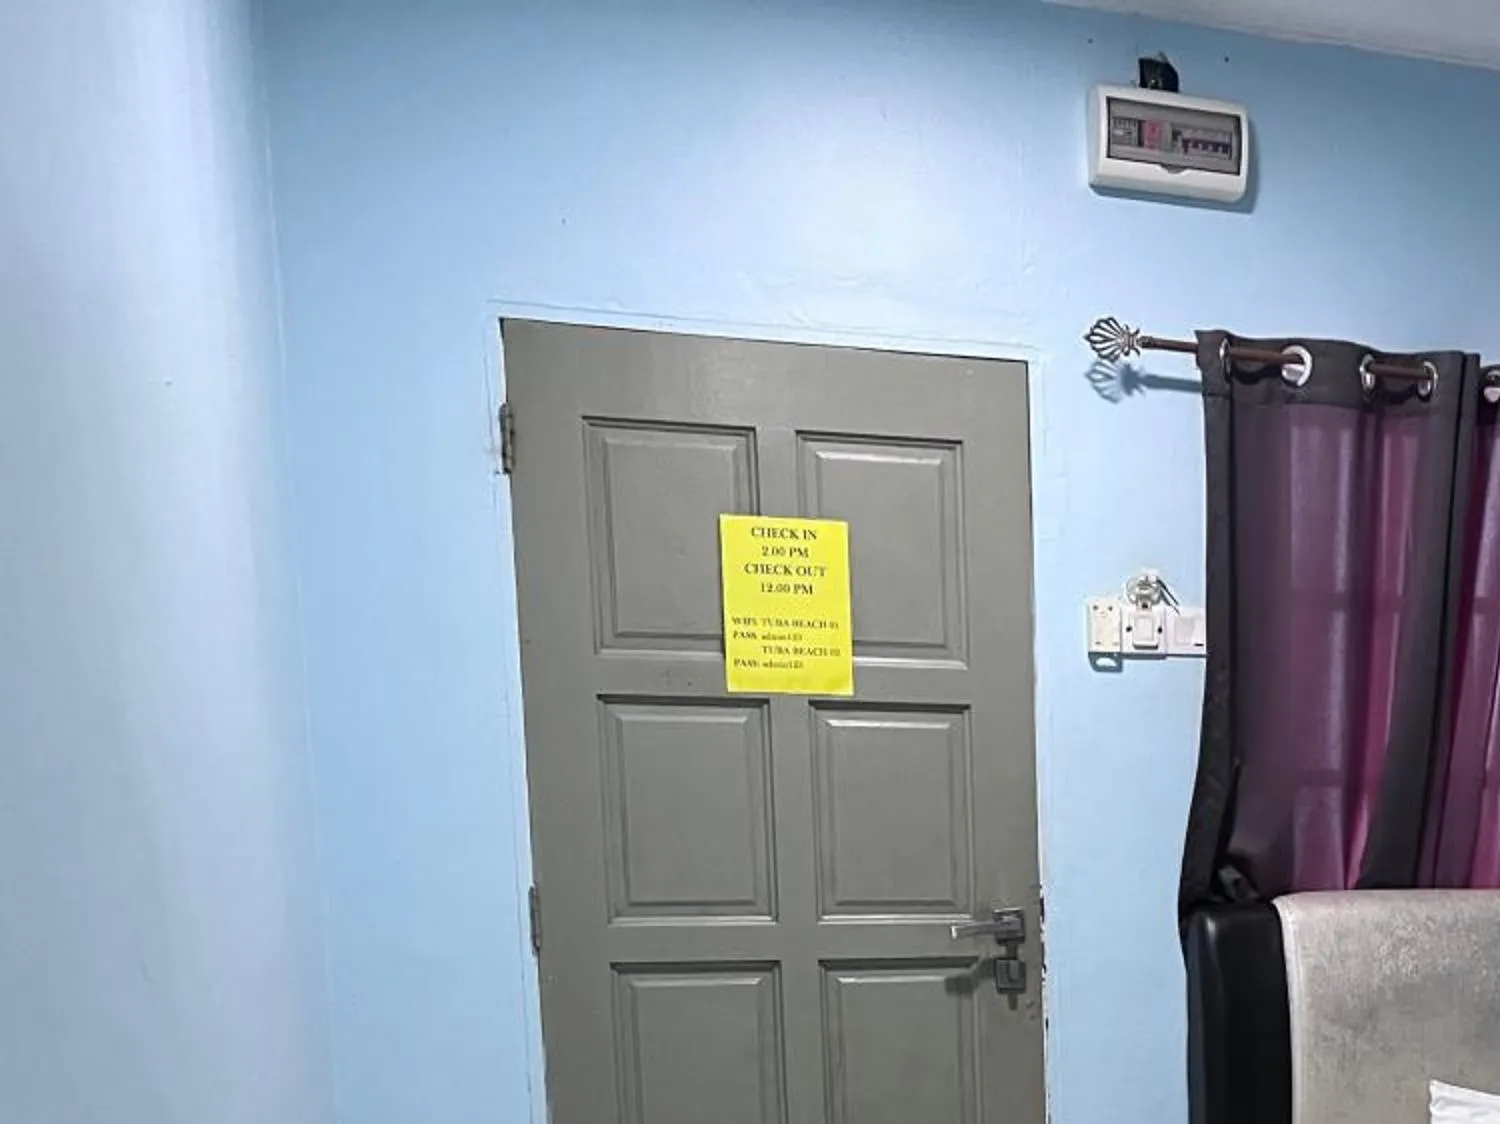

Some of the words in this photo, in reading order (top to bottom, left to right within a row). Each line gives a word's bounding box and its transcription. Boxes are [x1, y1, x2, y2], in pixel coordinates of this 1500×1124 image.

[751, 527, 798, 540] CHECK
[803, 529, 817, 540] IN
[761, 546, 786, 557] 2.00
[789, 547, 809, 558] PM
[744, 563, 793, 576] CHECK
[796, 565, 827, 577] OUT
[761, 583, 790, 594] 12.00
[793, 584, 813, 595] PM
[791, 619, 827, 629] BEACH
[793, 646, 827, 657] BEACH
